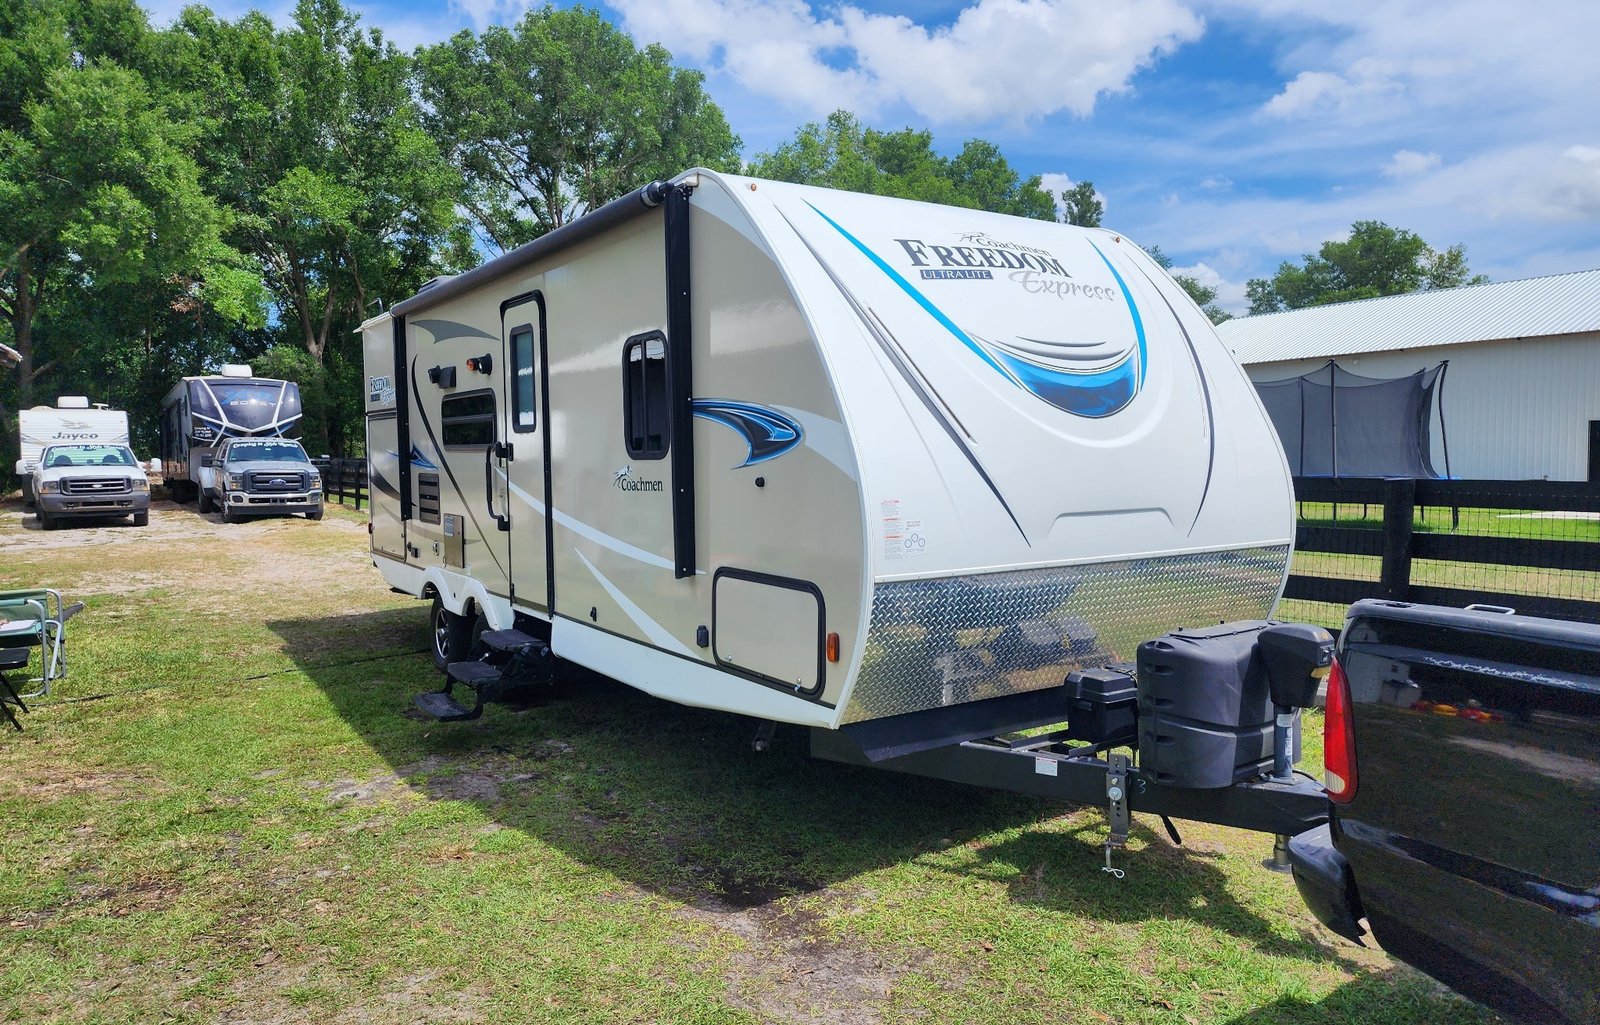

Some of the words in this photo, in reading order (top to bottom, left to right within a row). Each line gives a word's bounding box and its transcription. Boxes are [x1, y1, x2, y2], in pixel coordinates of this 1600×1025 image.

[976, 238, 1052, 257] Coachmen
[893, 239, 1072, 279] FREEDOM
[1008, 270, 1115, 301] Express
[52, 432, 99, 441] Jayco
[621, 476, 663, 492] Coachmen
